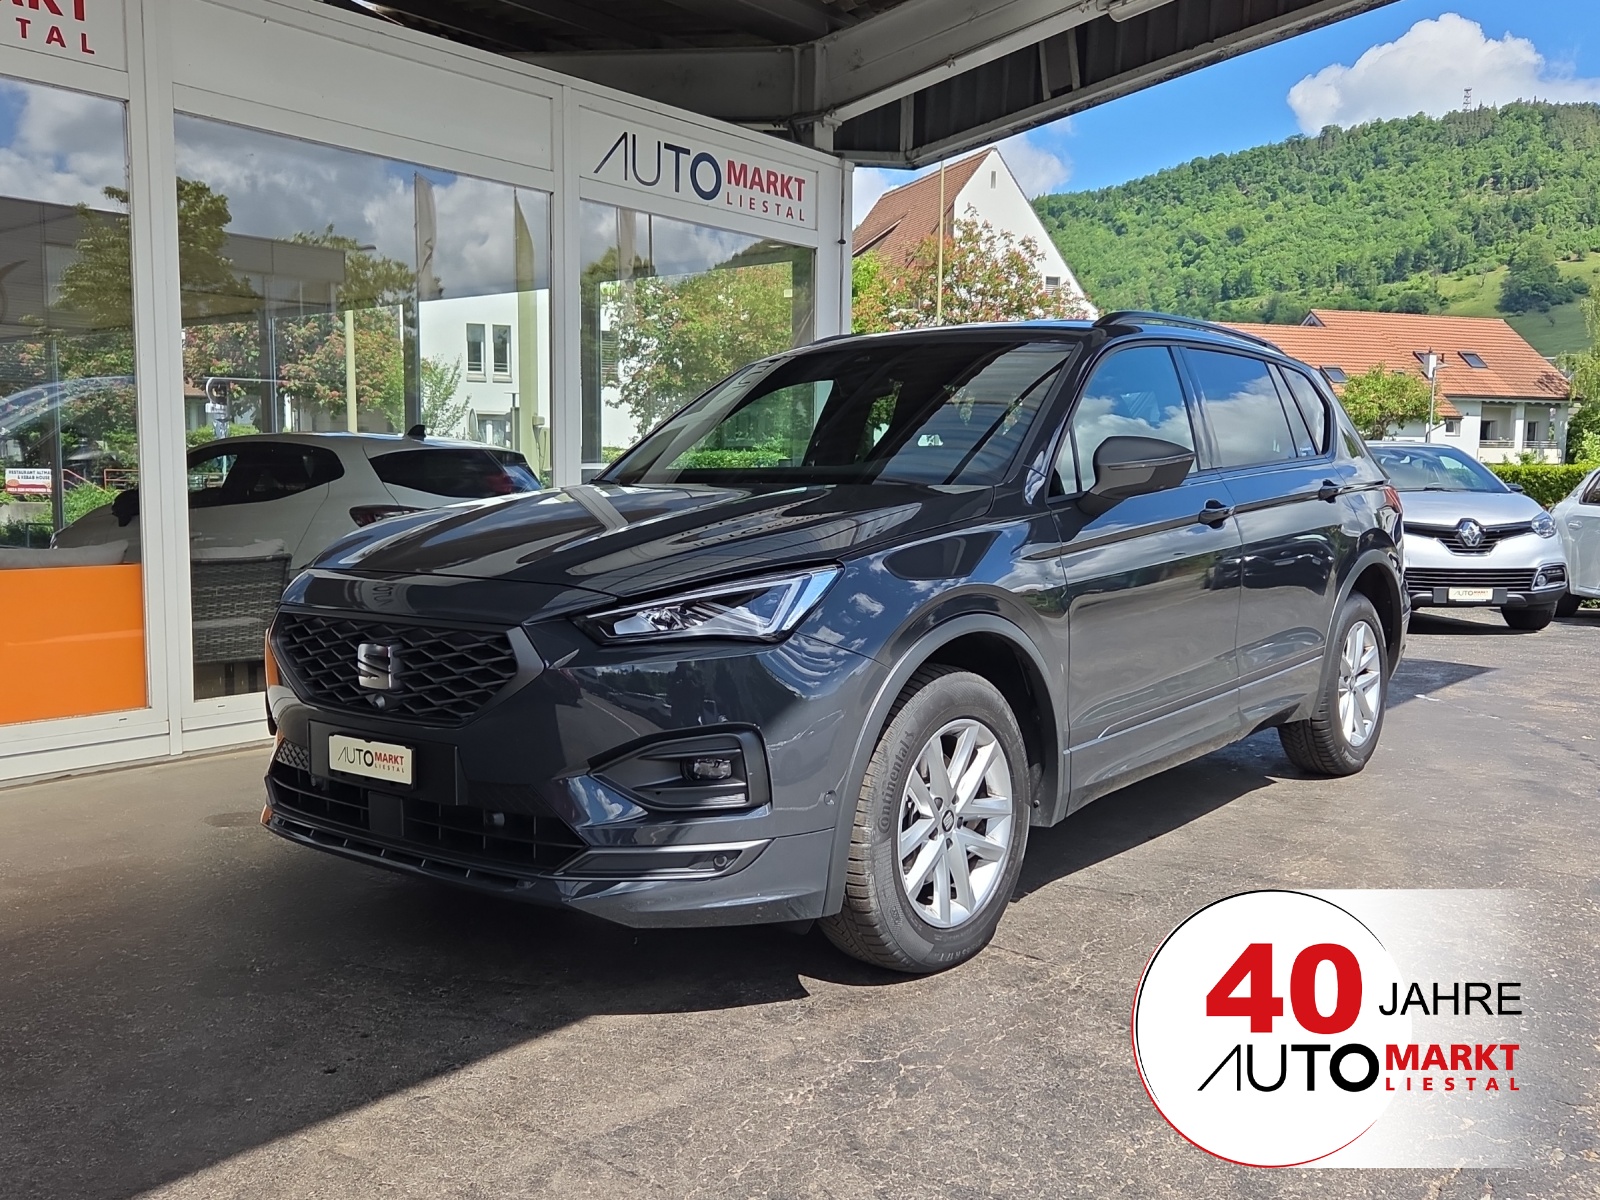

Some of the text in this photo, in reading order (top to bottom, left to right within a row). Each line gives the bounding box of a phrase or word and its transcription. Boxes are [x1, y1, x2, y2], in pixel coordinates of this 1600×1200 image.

[726, 191, 806, 222] LIESTAL
[374, 763, 405, 774] LIESTAL
[878, 739, 910, 834] Continental
